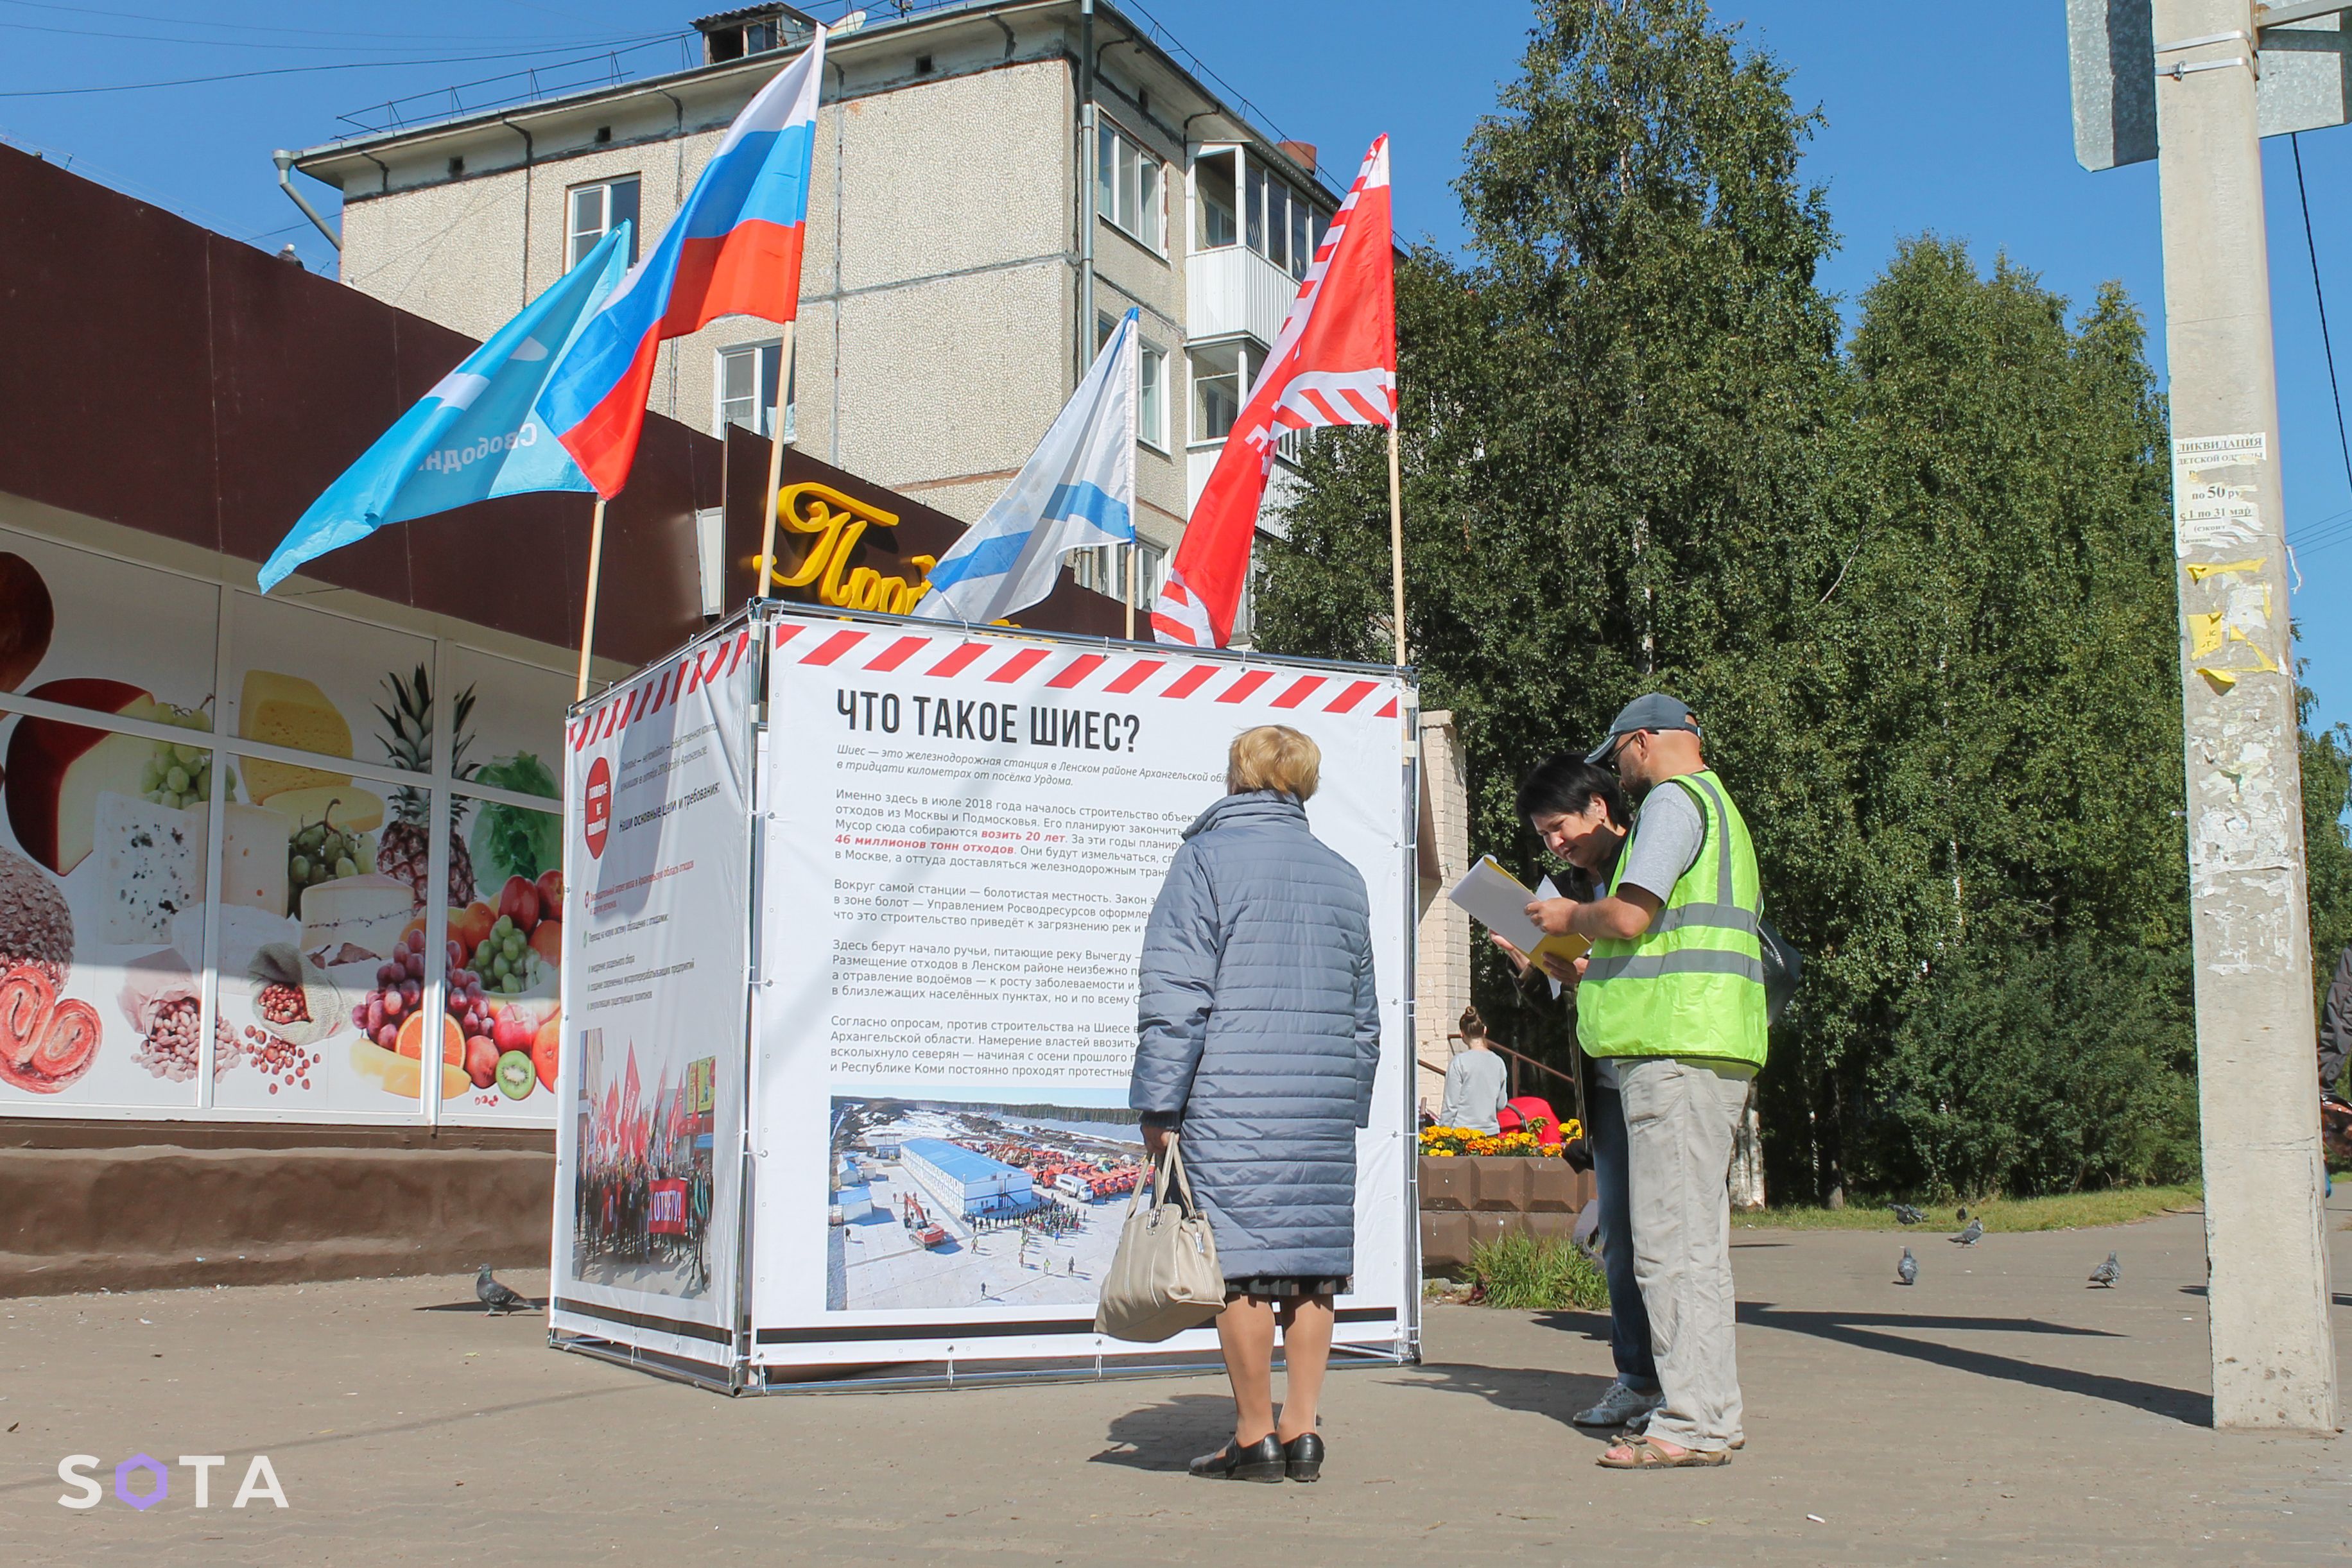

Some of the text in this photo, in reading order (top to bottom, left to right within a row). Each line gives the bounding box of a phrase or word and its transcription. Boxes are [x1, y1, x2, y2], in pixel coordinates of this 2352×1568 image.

[2177, 437, 2261, 452] ЛИКВИДАЦИЯ
[2177, 454, 2220, 466] ДЕТСКОЙ
[2207, 485, 2226, 499] 50
[2189, 510, 2194, 519] 1
[2214, 508, 2226, 517] 31
[837, 689, 1141, 752] ЧТО ТАКОЕ ШИЕС?
[836, 744, 866, 756] Шиес
[881, 749, 903, 759] это
[904, 751, 1001, 766] железнодорожная
[1003, 759, 1049, 771] станция
[1050, 762, 1057, 771] в
[1057, 761, 1100, 773] Ленском
[1101, 765, 1137, 777] районе
[1138, 768, 1208, 782] Архангельской
[836, 761, 1073, 786] в тридцати километрах от посёлка Урдома.
[835, 789, 881, 802] Именно
[885, 794, 918, 804] здесь
[921, 797, 928, 805] в
[931, 798, 962, 807] июле
[964, 798, 992, 809] 2018
[995, 802, 1022, 813] года
[1025, 804, 1077, 815] началось
[1078, 807, 1159, 820] строительство
[634, 805, 661, 827] основные
[834, 806, 884, 817] отходов
[887, 809, 901, 818] из
[903, 808, 948, 821] Москвы
[962, 812, 1040, 827] Подмосковья.
[1043, 818, 1062, 829] Его
[1064, 821, 1126, 834] планируют
[1128, 825, 1183, 838] закончить
[834, 818, 872, 833] Мусор
[875, 823, 906, 834] сюда
[908, 824, 978, 838] собираются
[980, 831, 1022, 840] возить
[1025, 831, 1041, 841] 20
[1043, 834, 1068, 843] лет.
[1071, 834, 1084, 844] За
[1087, 836, 1106, 845] эти
[1109, 838, 1136, 848] годы
[834, 834, 851, 845] 46
[854, 837, 926, 849] миллионов
[930, 841, 959, 851] тонн
[962, 844, 1016, 855] отходов.
[1019, 845, 1042, 856] Они
[1045, 846, 1078, 860] будут
[1081, 850, 1159, 863] измельчаться,
[834, 850, 842, 859] в
[844, 849, 891, 863] Москве,
[894, 854, 902, 863] а
[904, 855, 946, 866] оттуда
[948, 857, 1027, 870] доставляться
[1030, 862, 1136, 875] железнодорожным
[833, 879, 1147, 904] Вокруг самой станции болотистая местность. Закон
[833, 896, 840, 904] в
[843, 896, 872, 906] зоне
[874, 895, 910, 908] болот
[926, 899, 1004, 913] Управлением
[1007, 902, 1096, 918] Росводресурсов
[833, 911, 854, 920] что
[856, 912, 878, 921] это
[880, 913, 967, 926] строительство
[969, 917, 1025, 929] приведёт
[1037, 920, 1109, 932] загрязнению
[1111, 924, 1131, 934] рек
[832, 939, 1132, 964] Здесь берут начало ручьи, питающие реку Вычегду
[832, 954, 907, 968] Размещение
[910, 960, 958, 970] отходов
[961, 961, 968, 970] в
[971, 960, 1020, 972] Ленском
[1023, 962, 1064, 974] районе
[1066, 964, 1128, 976] неизбежно
[831, 971, 1134, 990] а отравление водоёмов к росту заболеваемости и
[831, 985, 1130, 1007] в близлежащих населённых пунктах, но и по всему
[831, 1015, 1130, 1033] Согласно опросам, против строительства на Шиесе
[829, 1031, 1136, 1048] Архангельской области. Намерение властей ввозить
[830, 1048, 1127, 1064] всколыхнуло северян начиная с осени прошлого
[829, 1064, 838, 1072] и
[841, 1062, 911, 1075] Республике
[914, 1063, 944, 1074] Коми
[947, 1065, 1009, 1075] постоянно
[1011, 1067, 1065, 1078] проходят
